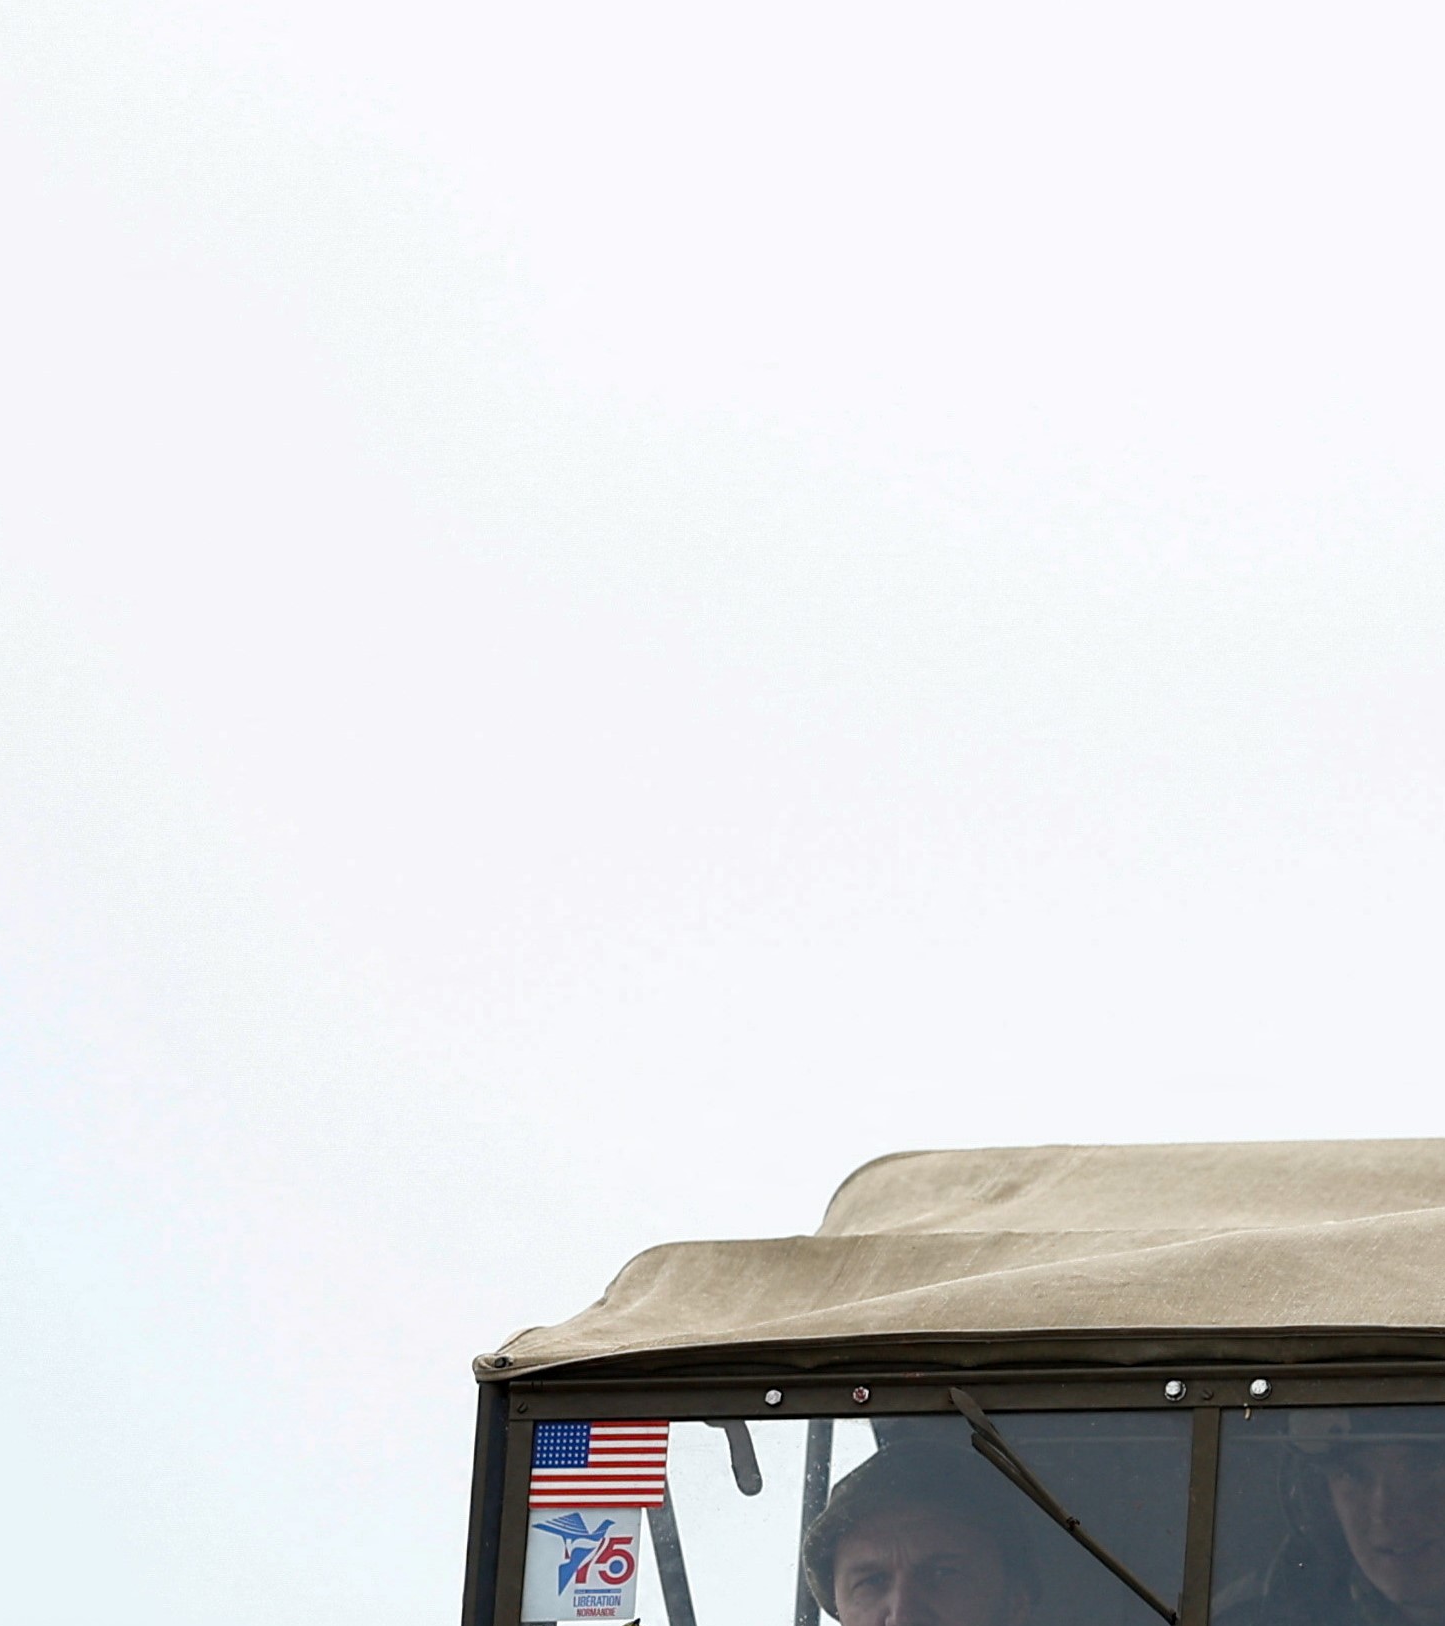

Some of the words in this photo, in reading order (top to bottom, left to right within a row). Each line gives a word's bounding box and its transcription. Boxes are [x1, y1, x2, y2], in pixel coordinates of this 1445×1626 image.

[564, 1536, 635, 1586] 75
[573, 1595, 622, 1607] LIBÉRATION
[576, 1607, 616, 1617] NORMANDIE
